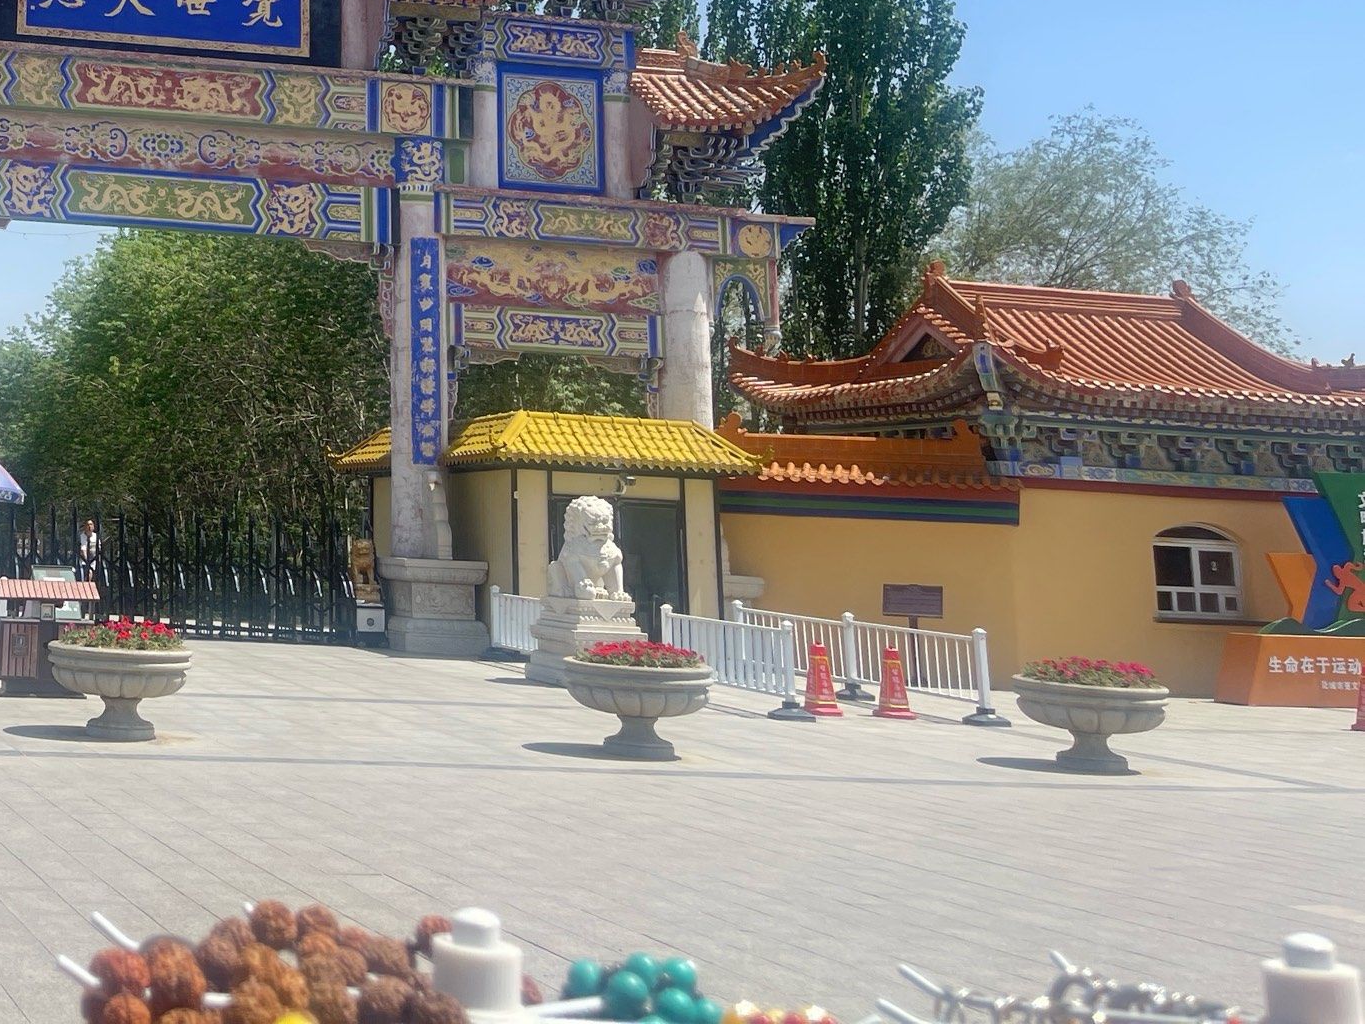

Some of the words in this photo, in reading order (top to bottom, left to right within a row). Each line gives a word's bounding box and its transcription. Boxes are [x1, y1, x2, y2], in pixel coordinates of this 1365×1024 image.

[1268, 656, 1362, 675] 生命在于运动
